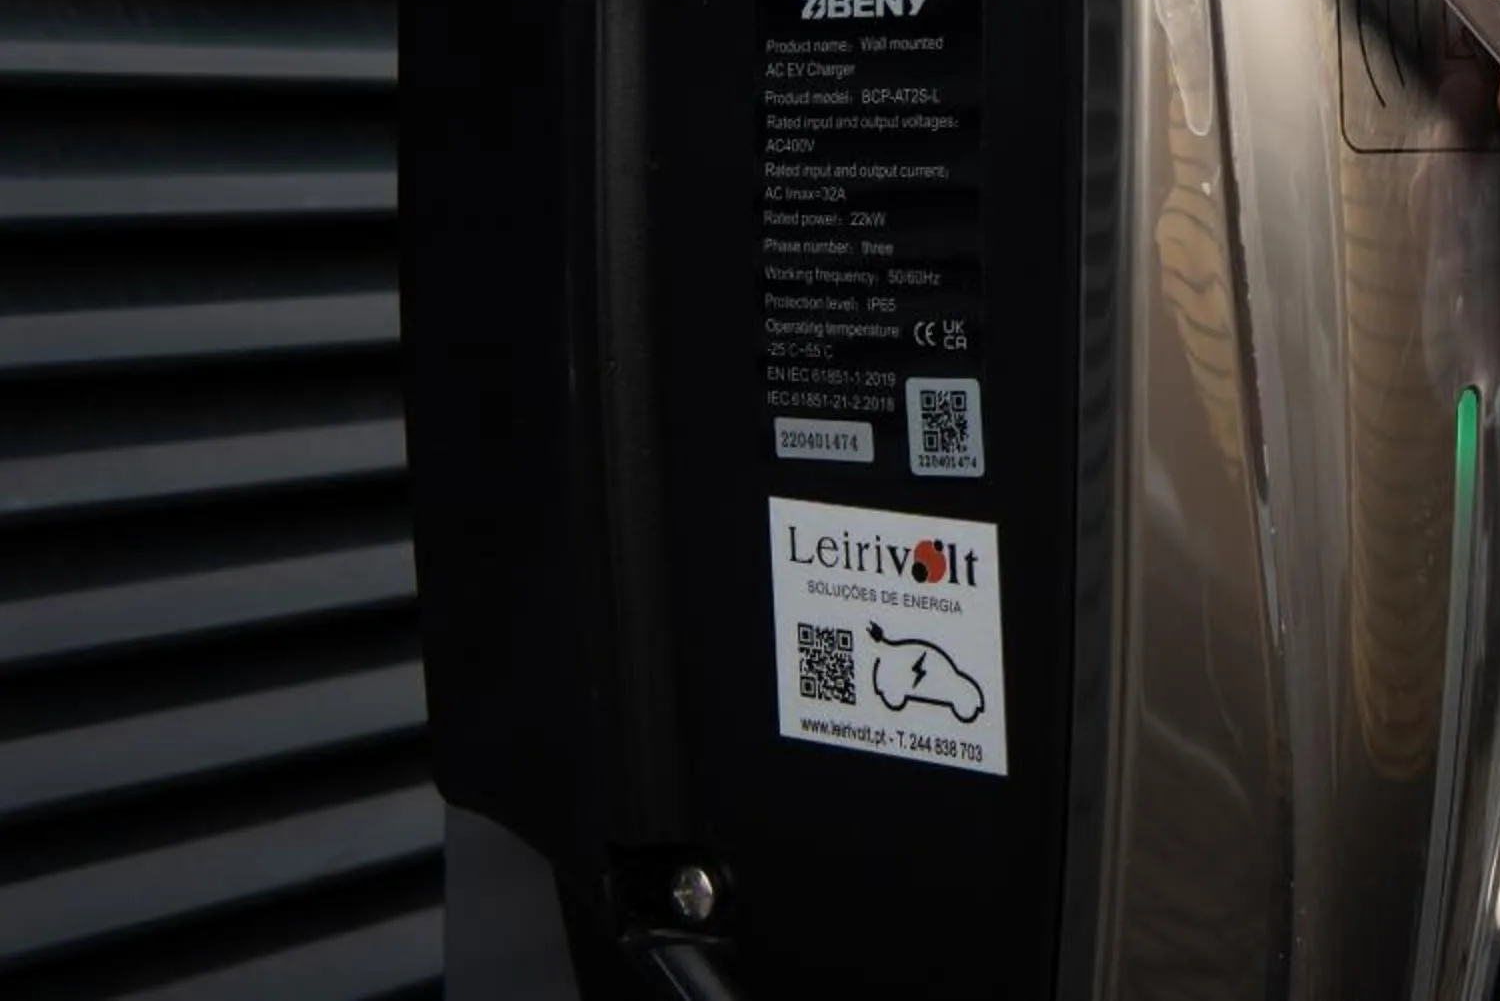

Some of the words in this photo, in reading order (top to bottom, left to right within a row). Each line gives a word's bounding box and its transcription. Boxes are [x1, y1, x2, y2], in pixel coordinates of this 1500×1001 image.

[765, 39, 811, 53] Product
[860, 36, 888, 51] Wall
[889, 36, 945, 51] mounted
[765, 62, 784, 78] AC
[787, 62, 805, 78] EV
[807, 61, 855, 80] Charger
[764, 90, 810, 105] Product
[767, 114, 802, 129] Rated
[804, 116, 833, 131] input
[836, 116, 858, 129] and
[860, 115, 899, 132] output
[765, 138, 815, 152] AC400V
[764, 161, 801, 177] Rated
[802, 163, 832, 179] input
[833, 162, 857, 177] and
[859, 163, 898, 179] output
[765, 186, 783, 200] AC
[763, 210, 799, 225] Rated
[850, 211, 888, 226] 22kW
[763, 237, 801, 253] Phase
[861, 240, 894, 256] three
[765, 265, 813, 286] Working
[765, 292, 824, 310] Protection
[765, 318, 824, 338] Operating
[943, 319, 965, 335] UK
[943, 335, 968, 350] CA
[767, 366, 785, 382] EN
[787, 366, 810, 383] IEC
[767, 390, 791, 407] IEC
[788, 526, 979, 587] Leirivolt
[807, 579, 877, 603] SOLUÇÕES
[881, 591, 899, 606] DE
[903, 593, 963, 614] ENERGIA
[909, 734, 932, 753] 244
[960, 743, 983, 763] 703
